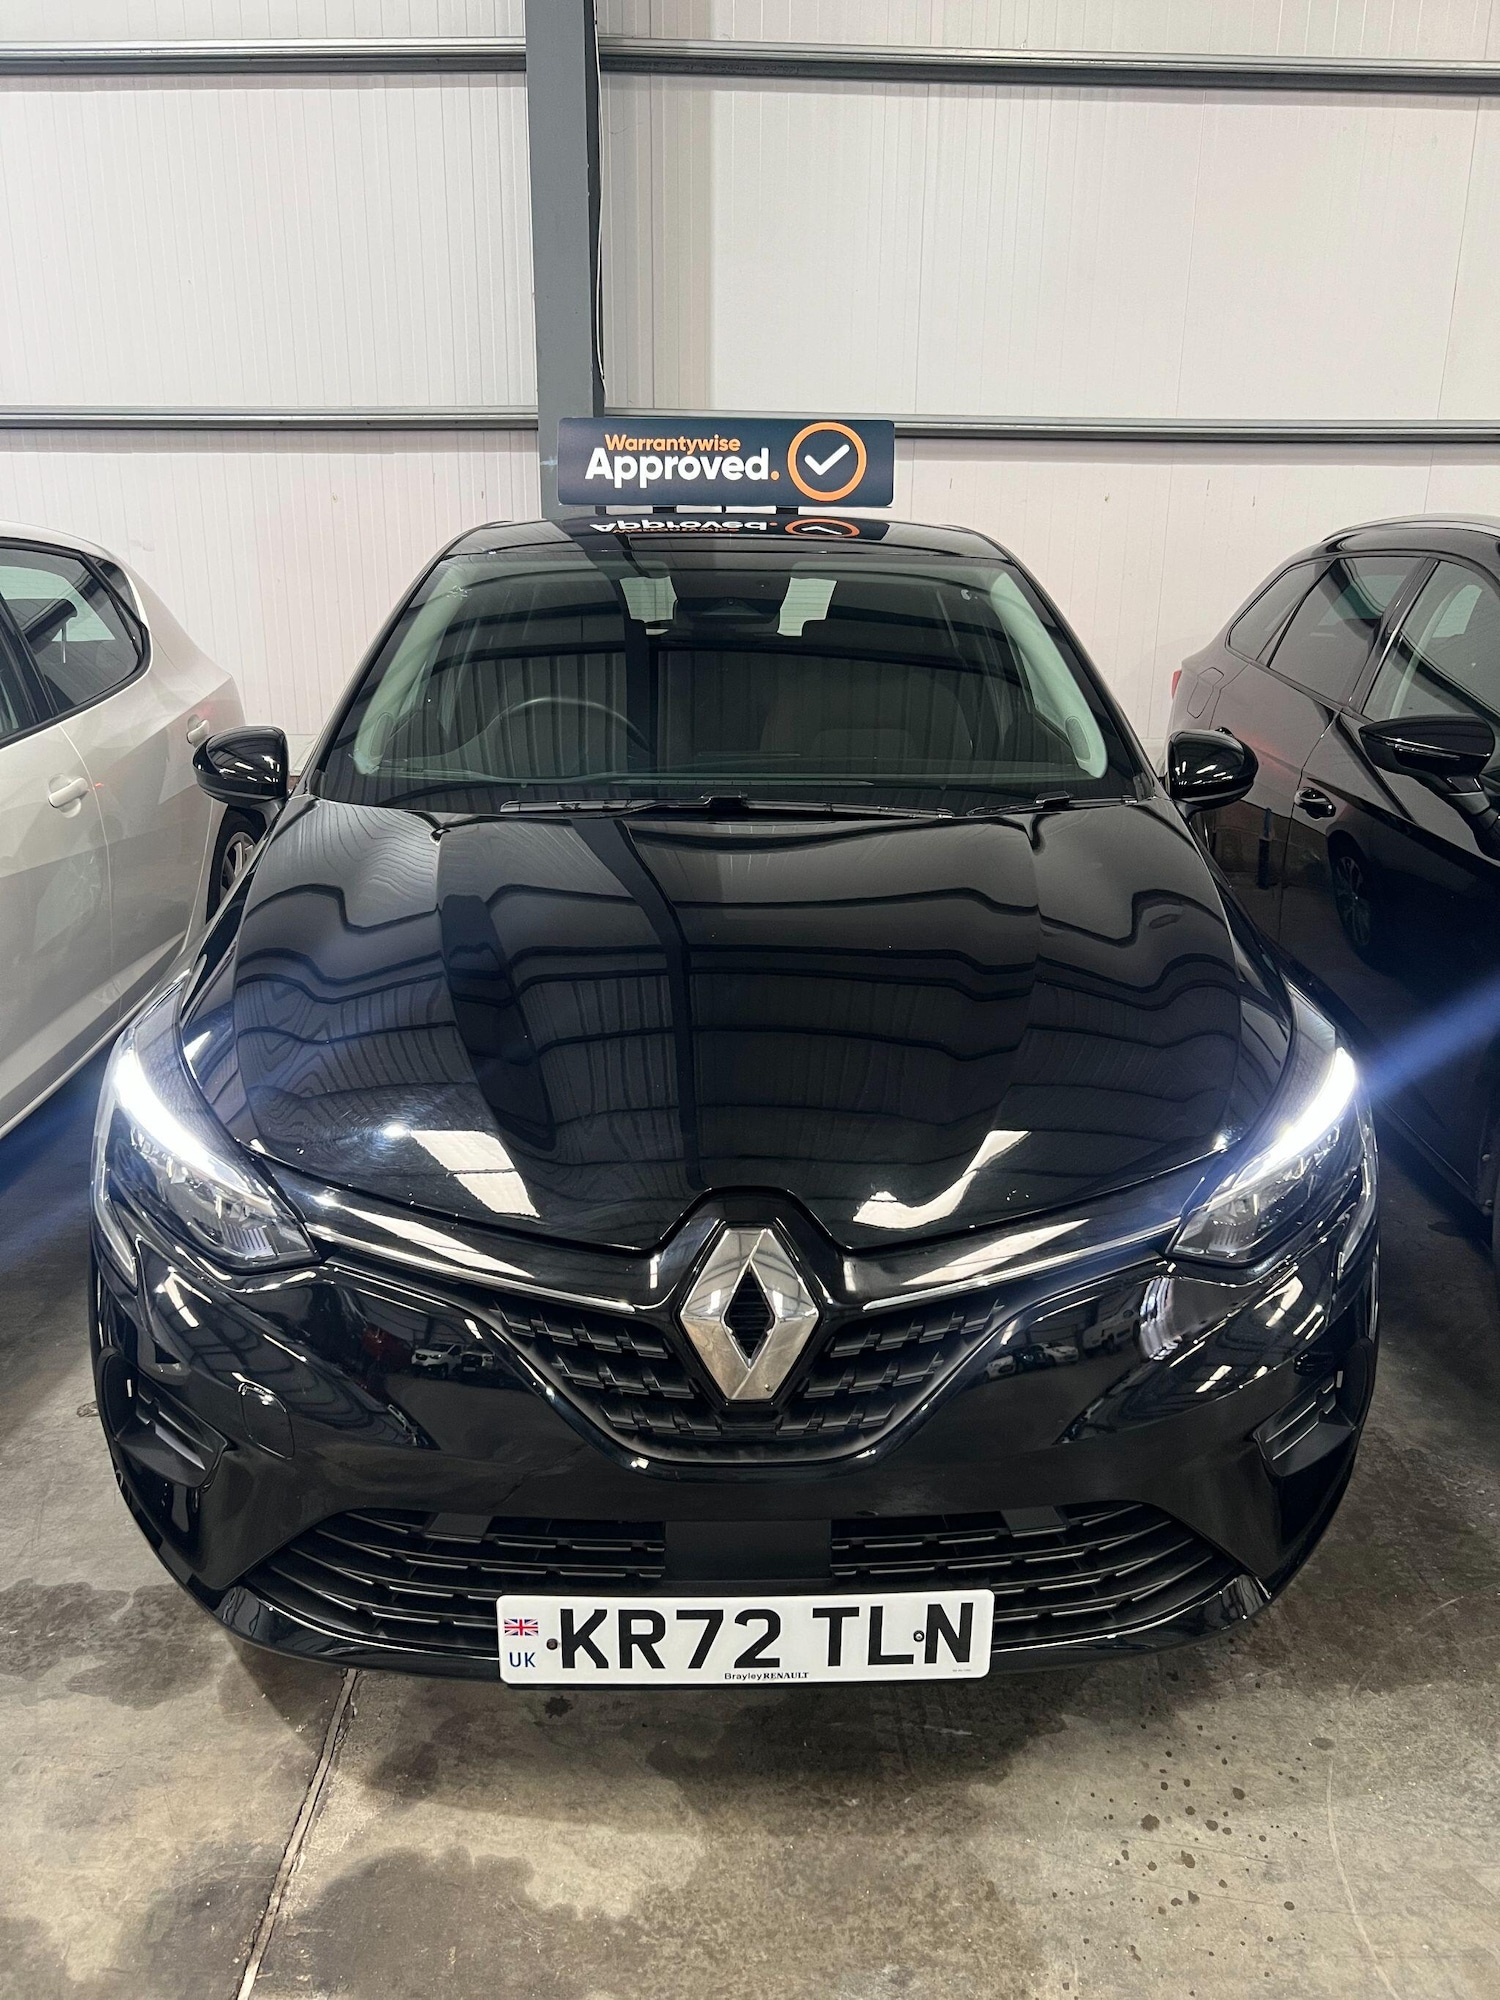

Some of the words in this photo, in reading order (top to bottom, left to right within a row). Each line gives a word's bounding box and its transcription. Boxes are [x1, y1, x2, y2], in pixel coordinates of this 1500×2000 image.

[604, 434, 741, 456] Warrantywise
[584, 447, 780, 489] Approved.
[560, 1608, 781, 1669] KR72
[812, 1602, 974, 1667] TLN
[508, 1651, 536, 1668] UK
